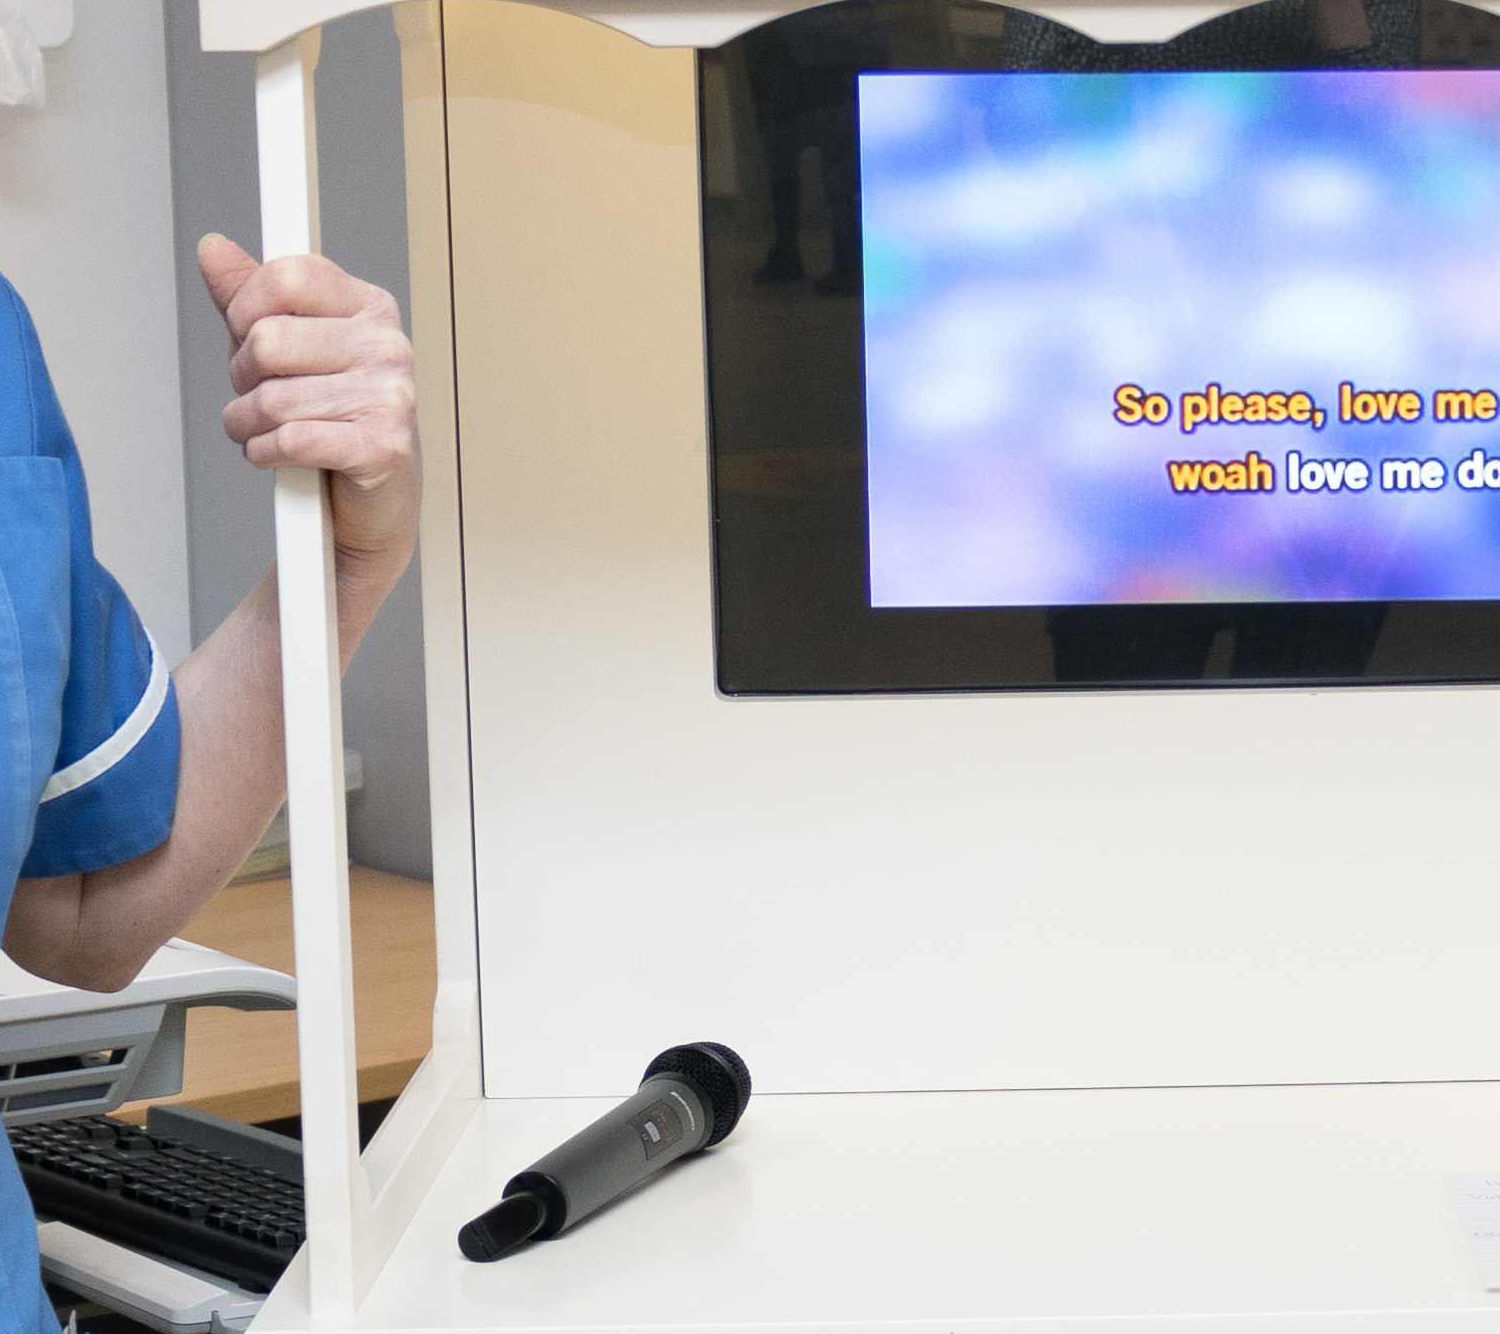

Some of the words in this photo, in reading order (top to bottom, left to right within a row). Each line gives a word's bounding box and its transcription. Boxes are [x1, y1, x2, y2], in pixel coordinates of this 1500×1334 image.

[1115, 385, 1169, 424] So
[1180, 383, 1326, 433] please,
[1339, 381, 1422, 423] love
[1433, 388, 1498, 422] me
[1168, 451, 1275, 492] woah
[1286, 450, 1370, 492] love
[1381, 458, 1445, 490] me
